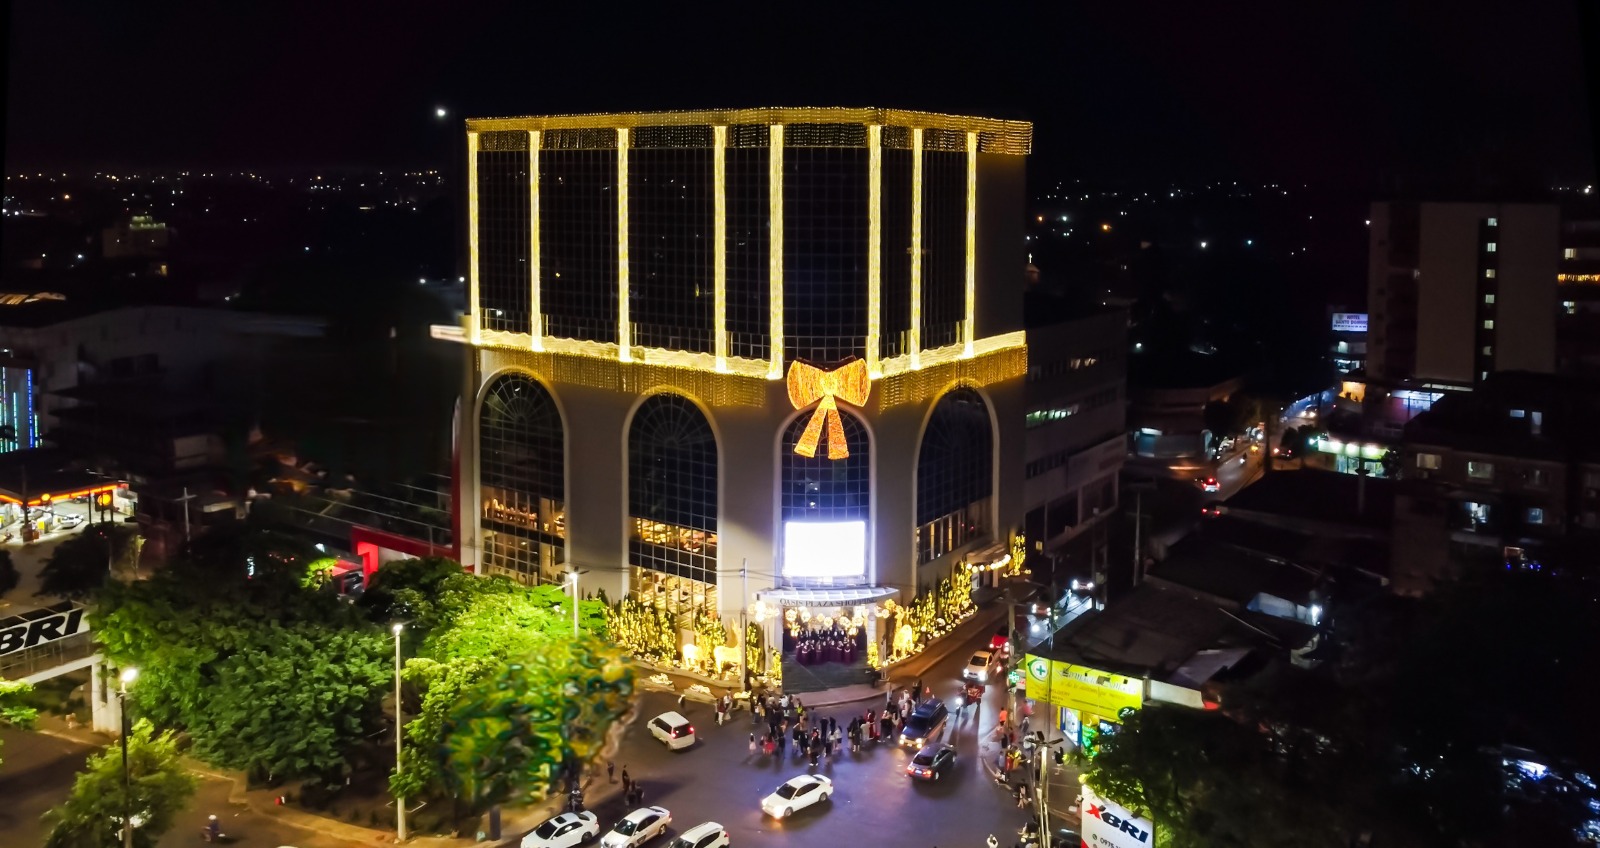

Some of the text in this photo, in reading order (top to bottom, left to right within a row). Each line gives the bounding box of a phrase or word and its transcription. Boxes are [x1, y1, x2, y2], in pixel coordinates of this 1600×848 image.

[780, 598, 803, 606] OASIS
[836, 597, 877, 607] SHOPPING
[1085, 803, 1149, 843] XBRI
